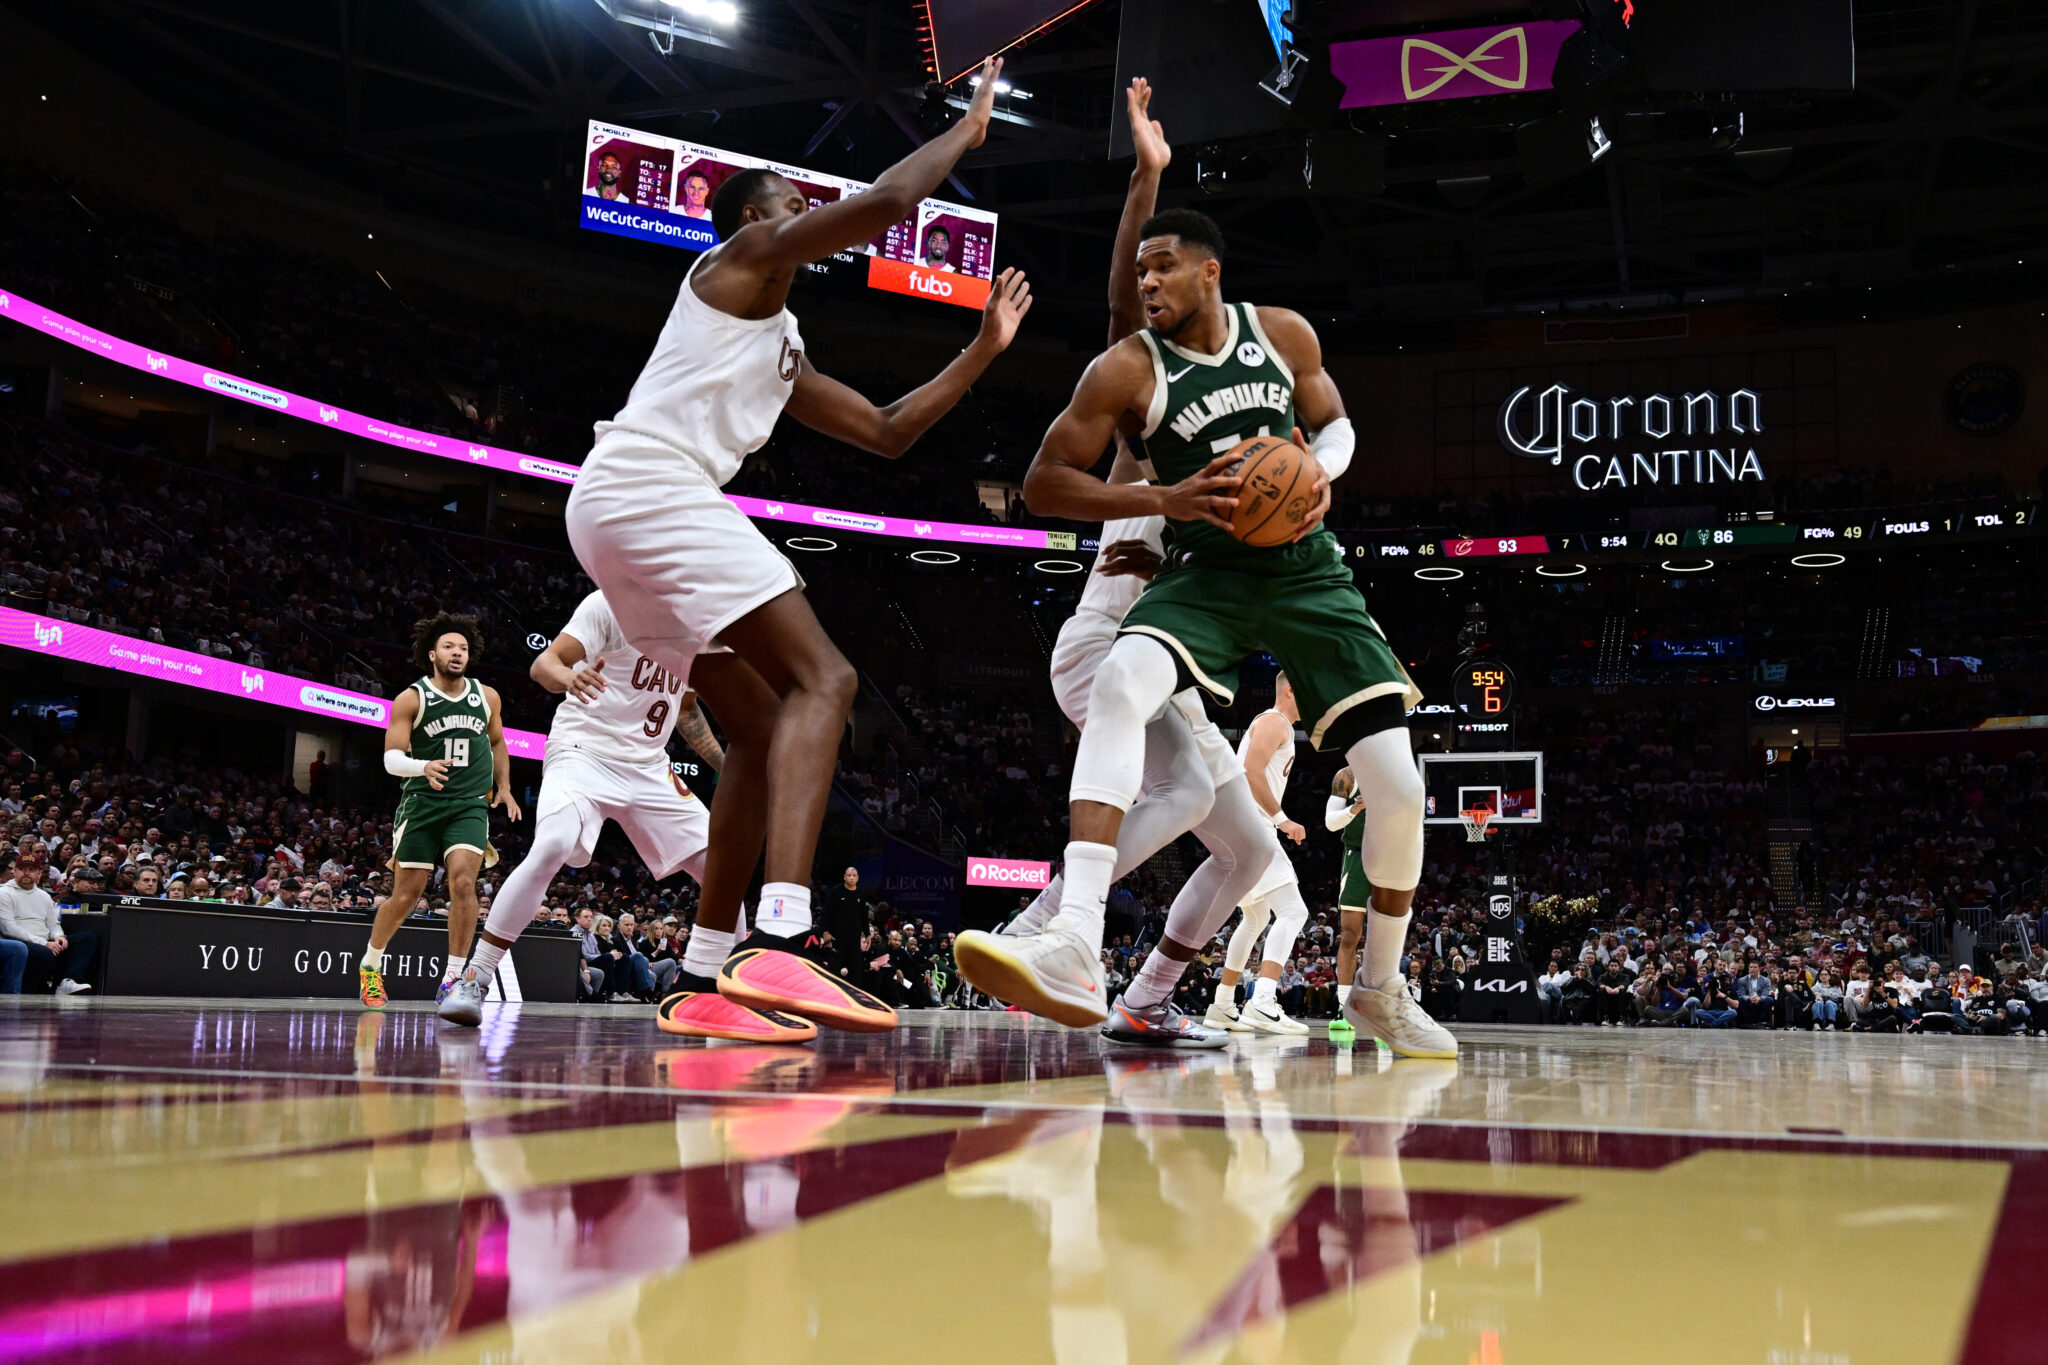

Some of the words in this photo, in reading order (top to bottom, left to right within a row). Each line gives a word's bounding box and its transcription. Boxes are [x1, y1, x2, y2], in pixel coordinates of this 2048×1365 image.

[602, 127, 631, 138] MOBLEY
[690, 147, 719, 159] MERRILL
[933, 204, 961, 214] MITCHELL
[586, 206, 714, 243] WeCutCarbon.com
[828, 252, 854, 263] ROM
[909, 270, 953, 297] fubo
[42, 316, 64, 331] Game
[65, 327, 81, 338] plan
[82, 334, 97, 345] your
[99, 341, 113, 351] ride
[147, 353, 168, 371] lyft
[218, 379, 238, 390] Where
[319, 406, 338, 423] lyft
[1169, 382, 1291, 442] MILWAUKEE
[1498, 382, 1766, 465] Corona
[367, 424, 388, 436] Game
[389, 431, 405, 440] plan
[469, 446, 488, 461] lyft
[1573, 448, 1766, 491] CANTINA
[766, 503, 784, 517] lyft
[914, 523, 932, 536] lyft
[1047, 532, 1075, 540] TONIGHT'S
[1356, 546, 1365, 558] 0
[1381, 545, 1409, 556] FG%
[1418, 544, 1435, 556] 46
[1498, 540, 1518, 553] 93
[1562, 539, 1570, 550] 7
[1601, 536, 1628, 548] 9:54
[1654, 532, 1678, 546] 4Q
[1713, 530, 1734, 544] 86
[1804, 528, 1835, 539] FG%
[1844, 526, 1862, 539] 49
[1885, 521, 1930, 535] FOULS
[1944, 519, 1952, 531] 1
[1975, 515, 2003, 527] TOL
[2015, 512, 2025, 525] 2
[1053, 541, 1068, 549] TOTAL
[35, 621, 63, 647] lyft
[109, 644, 139, 660] Game
[140, 653, 161, 666] plan
[163, 659, 184, 670] your
[185, 663, 203, 675] ride
[241, 671, 264, 693] lyft
[631, 655, 683, 695] CAV
[1472, 671, 1505, 686] 9:54
[316, 693, 336, 705] Where
[337, 700, 347, 708] are
[348, 703, 359, 711] you
[359, 705, 379, 717] going?
[1484, 686, 1501, 713] 6
[1777, 697, 1836, 708] LEXUS
[423, 715, 486, 739] MILWAUKEE
[643, 700, 670, 738] 9
[1472, 723, 1509, 732] TISSOT
[443, 738, 470, 767] 19
[988, 864, 1046, 884] Rocket
[885, 875, 956, 890] LECOM
[120, 895, 142, 906] anc
[1491, 901, 1510, 916] ups
[1487, 937, 1511, 950] Elk
[199, 943, 264, 971] YOU
[294, 949, 353, 975] GOT
[381, 953, 440, 978] THIS
[1487, 950, 1511, 962] Elk
[1474, 978, 1528, 993] KIA
